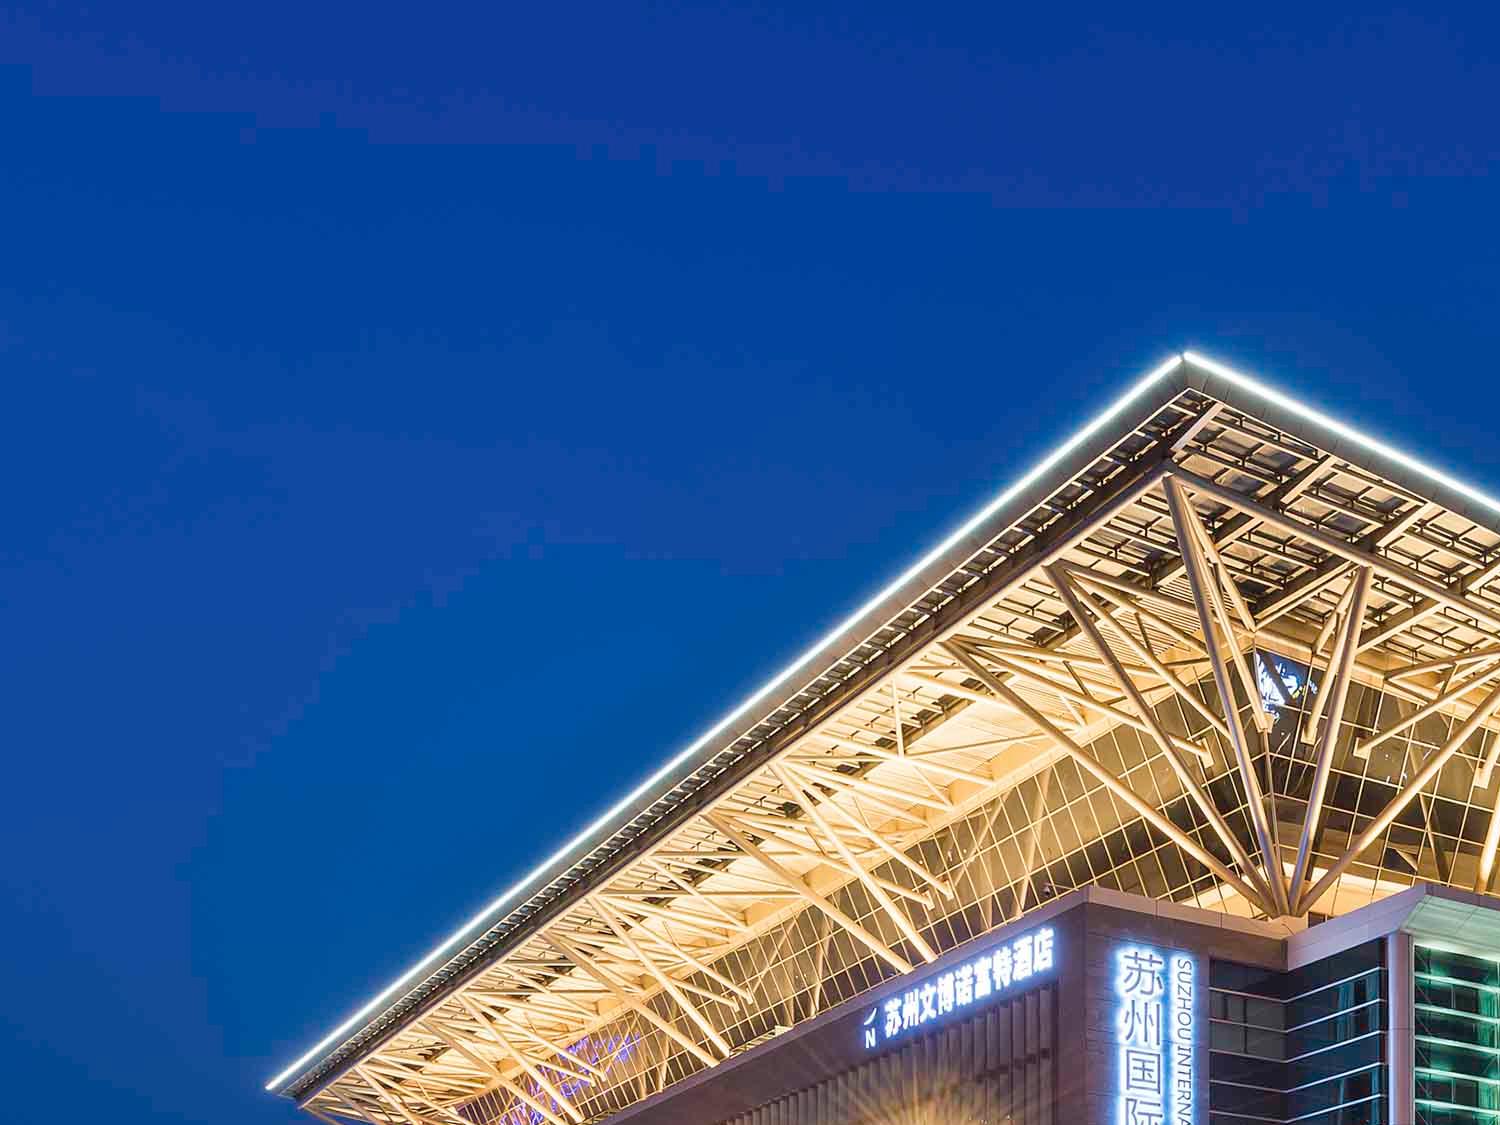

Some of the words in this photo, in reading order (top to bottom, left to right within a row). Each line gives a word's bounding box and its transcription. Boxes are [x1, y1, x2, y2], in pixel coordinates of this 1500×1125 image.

[883, 926, 1055, 1039] 苏州文博诺富特酒店
[1177, 958, 1192, 1041] SUZHOU
